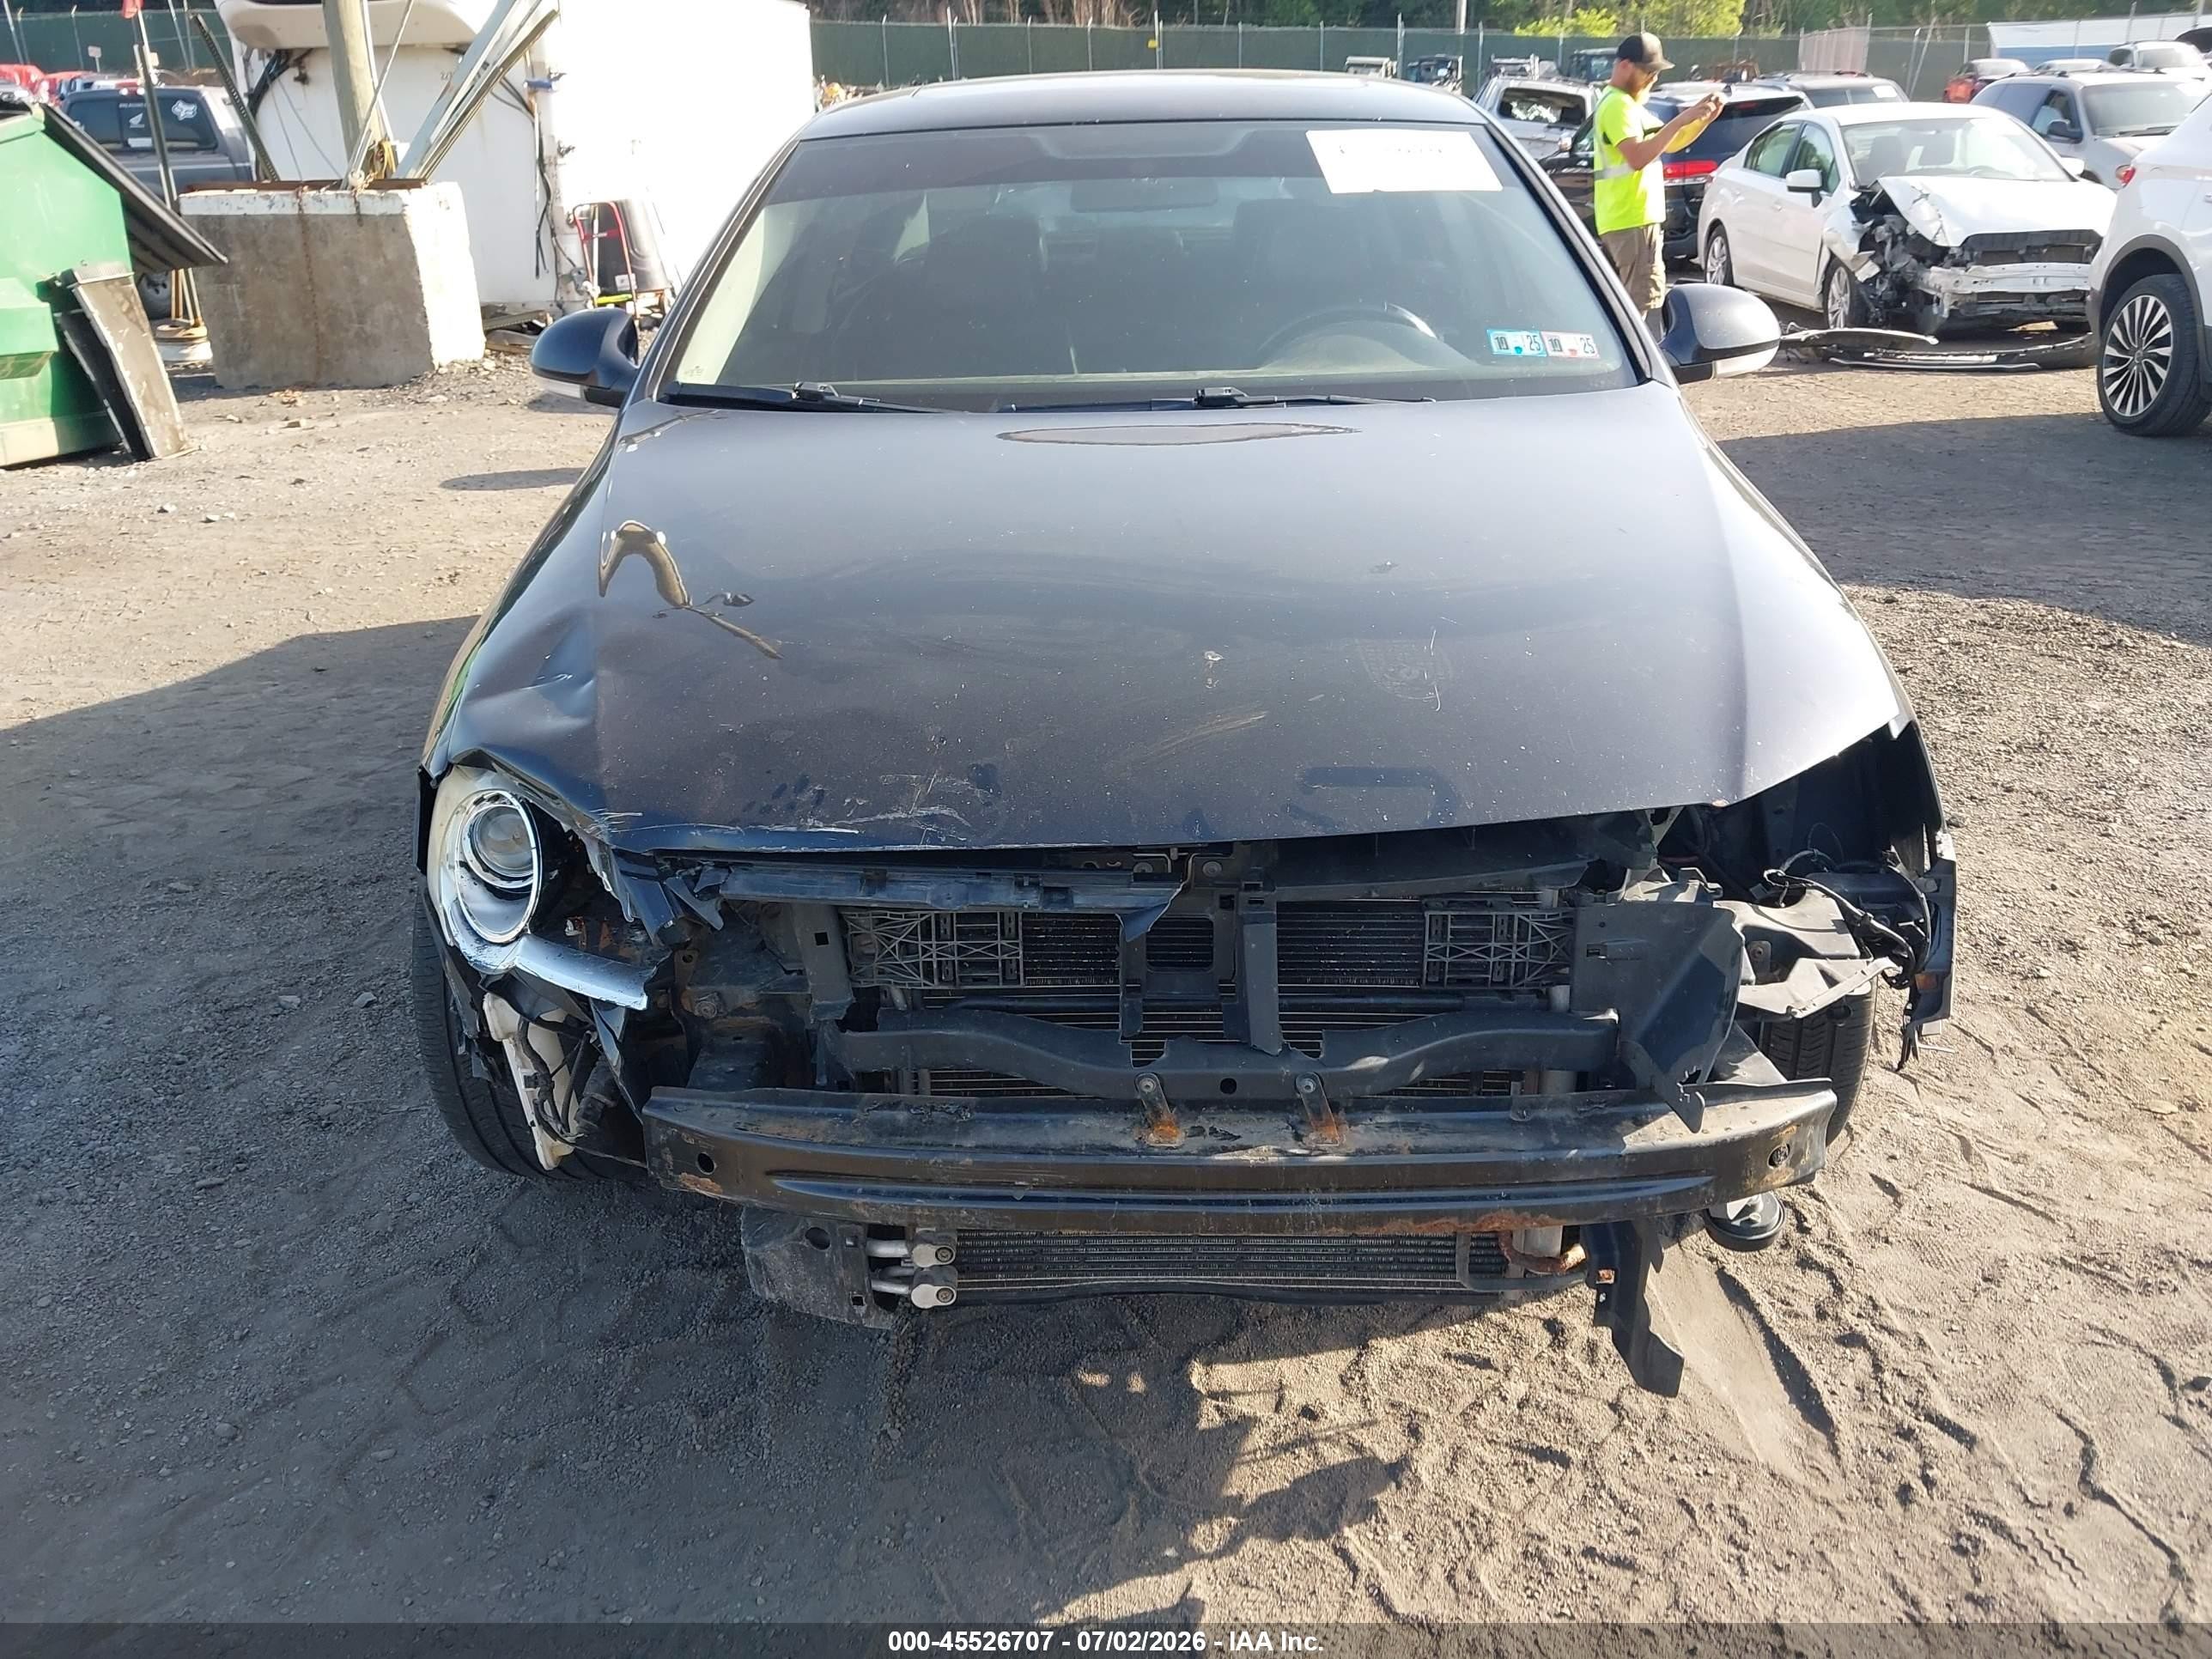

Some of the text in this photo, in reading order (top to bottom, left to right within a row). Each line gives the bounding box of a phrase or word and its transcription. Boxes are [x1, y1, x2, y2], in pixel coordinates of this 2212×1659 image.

[1495, 335, 1541, 351] 10 25
[1548, 337, 1596, 354] 10 25
